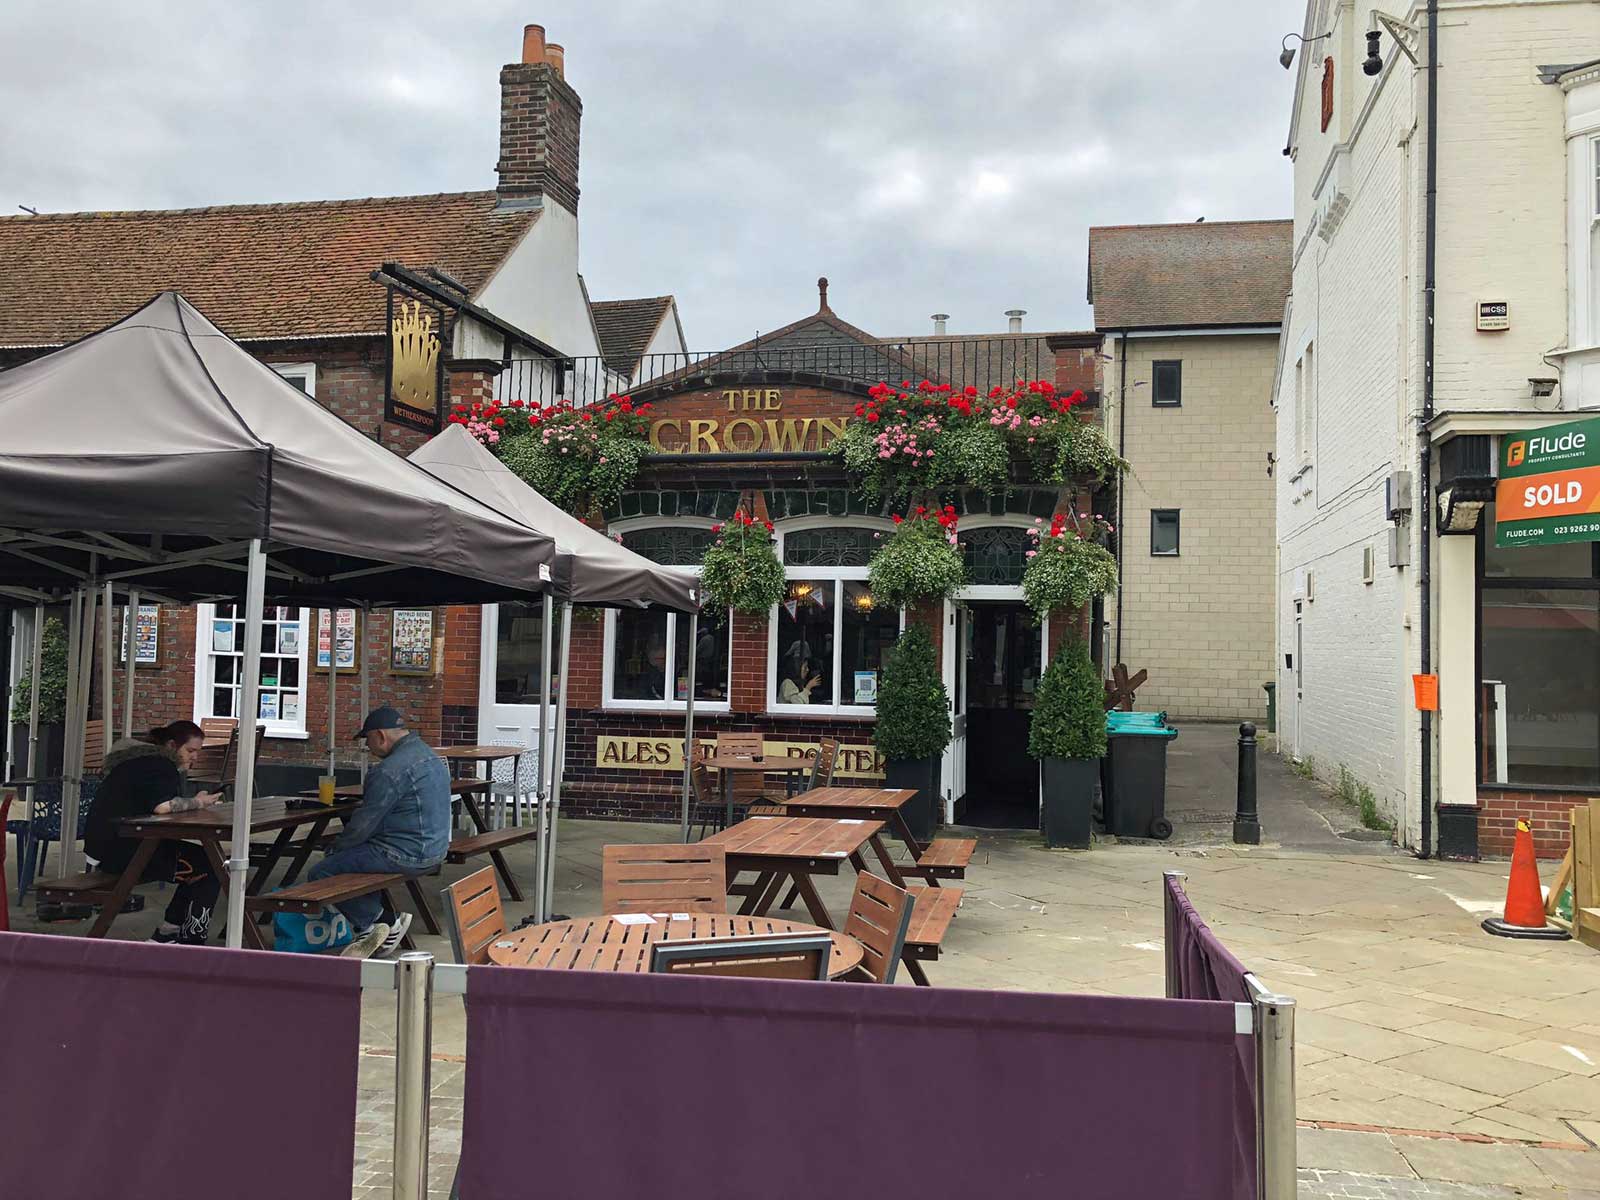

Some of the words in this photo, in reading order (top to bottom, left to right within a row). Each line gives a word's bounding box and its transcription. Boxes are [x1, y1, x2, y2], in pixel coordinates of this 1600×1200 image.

[722, 389, 783, 412] THE
[648, 416, 850, 455] CROWN
[1528, 432, 1586, 456] Flude
[1528, 456, 1551, 464] PROPERTY
[1551, 451, 1586, 461] CONSULTANTS
[1523, 481, 1583, 508] SOLD
[1506, 528, 1544, 538] FLUDE.COM
[1554, 526, 1568, 534] 023
[1569, 524, 1588, 533] 9262
[602, 741, 671, 765] ALES
